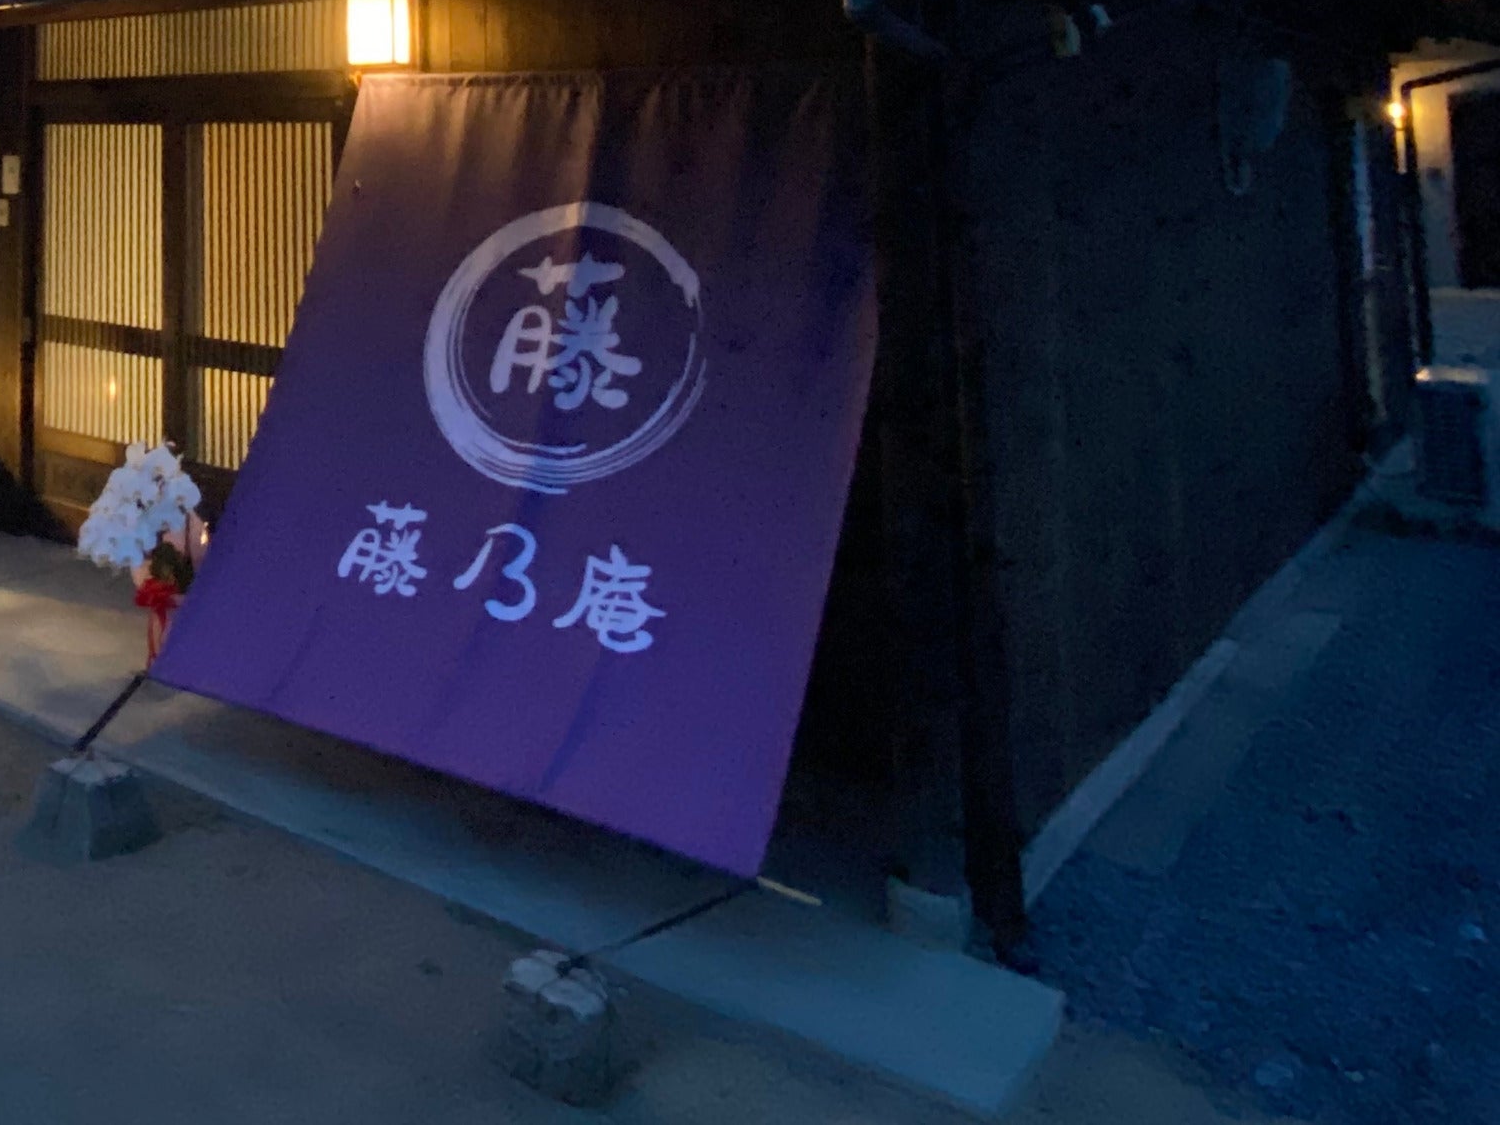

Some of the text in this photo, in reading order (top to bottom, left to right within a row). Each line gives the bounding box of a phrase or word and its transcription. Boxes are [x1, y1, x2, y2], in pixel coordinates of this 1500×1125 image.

[489, 251, 642, 410] 藤
[337, 500, 667, 653] 藤乃庵
